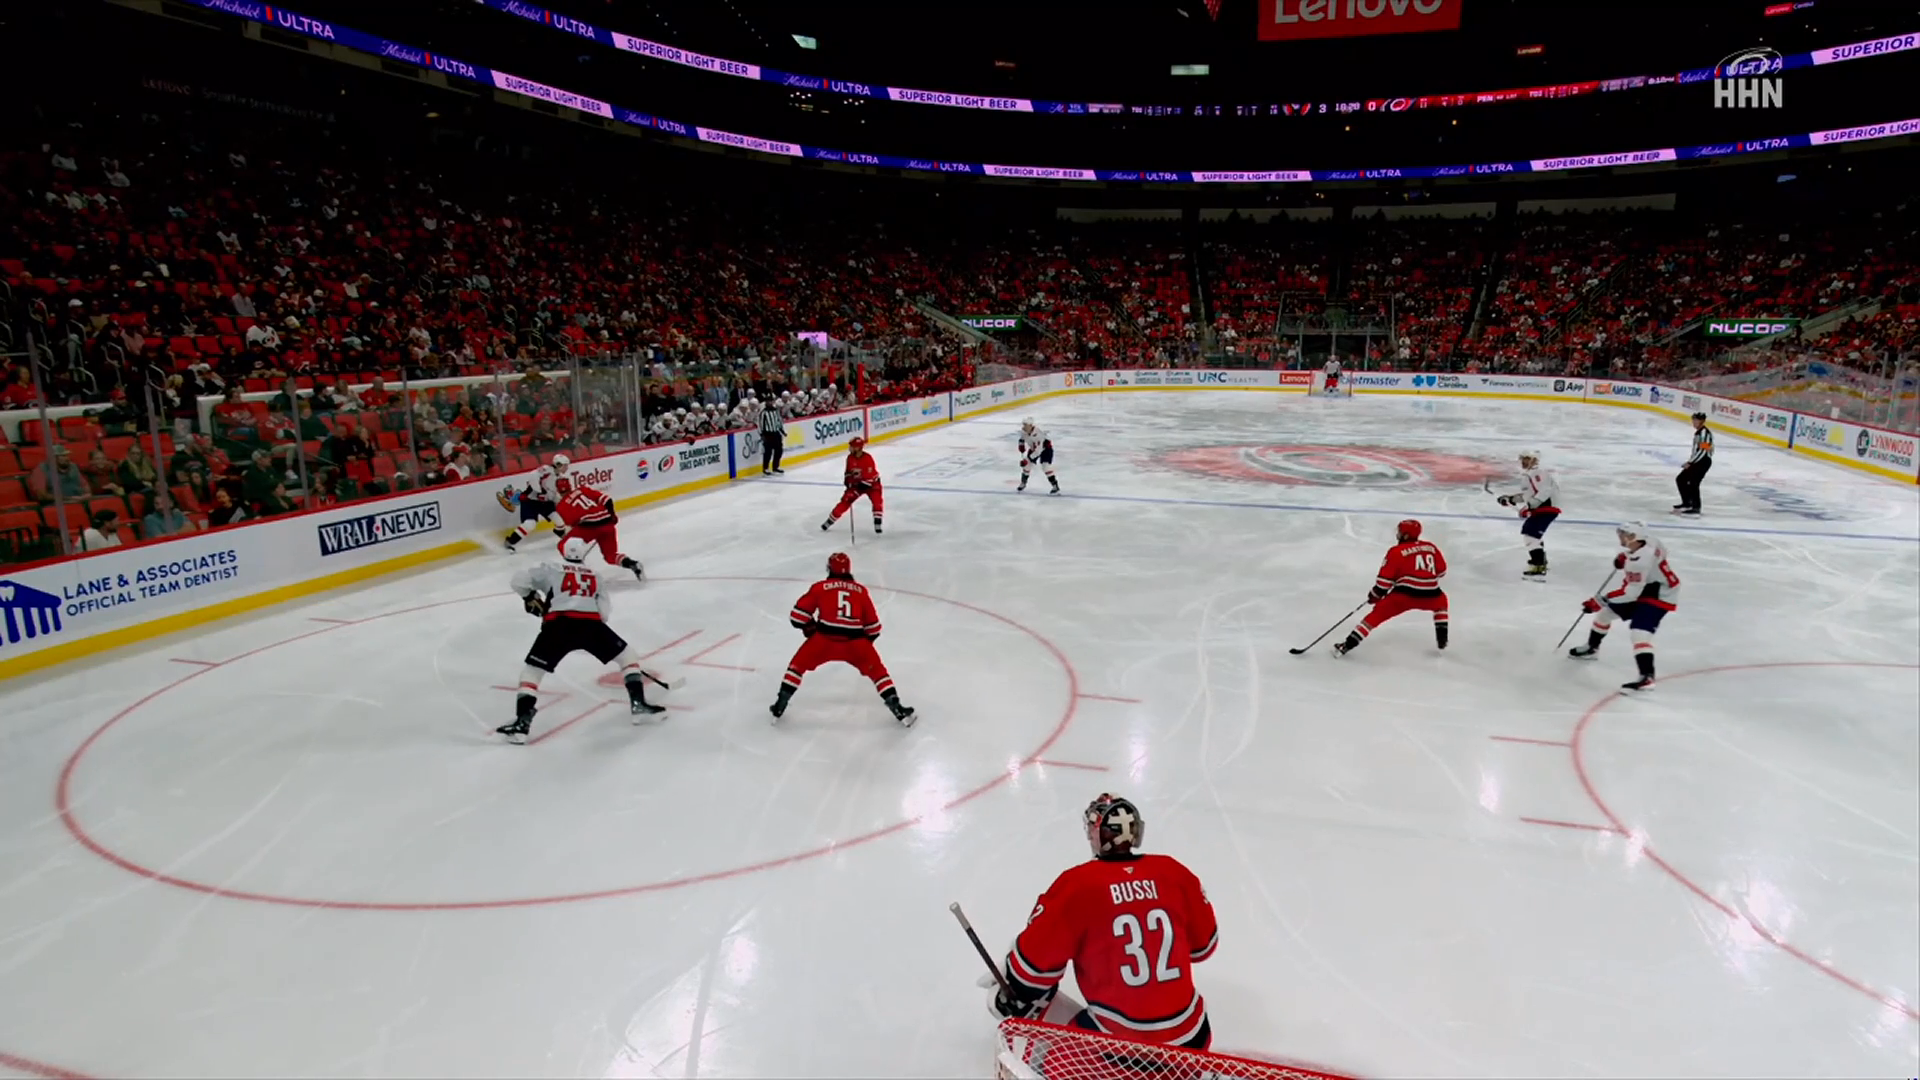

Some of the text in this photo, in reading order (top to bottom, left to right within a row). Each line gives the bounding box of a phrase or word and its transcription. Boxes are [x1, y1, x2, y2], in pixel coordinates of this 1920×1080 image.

[1275, 0, 1443, 24] Lenovo
[278, 10, 335, 39] ULTRA
[553, 14, 595, 39] ULTRA
[627, 38, 749, 76] SUPERIOR LIGHT BEER
[1831, 35, 1915, 61] SUPERIOR
[433, 56, 476, 79] ULTRA
[504, 76, 602, 113] SUPERIOR LIGHT BEER
[831, 81, 871, 96] ULTRA
[898, 90, 1017, 109] SUPERIOR LIGHT BEER
[1318, 104, 1327, 113] 3
[658, 119, 686, 135] ULTRA
[1823, 125, 1887, 142] SUPERIOR
[706, 131, 791, 153] SUPERIOR LIGHT BEER
[1746, 138, 1789, 151] ULTRA
[848, 153, 879, 164] ULTRA
[940, 162, 971, 173] ULTRA
[1542, 151, 1660, 169] SUPERIOR LIGHT BEER
[993, 167, 1034, 176] SUPERIOR
[1036, 169, 1061, 177] LIGHT
[1146, 173, 1178, 181] ULTRA
[1201, 172, 1245, 180] SUPERIOR
[1275, 172, 1299, 180] BEER
[1366, 169, 1402, 178] ULTRA
[1476, 163, 1514, 174] ULTRA
[961, 318, 1017, 328] NUCOR
[1074, 373, 1094, 385] PNC
[1197, 372, 1228, 383] UNC
[815, 417, 860, 444] Spectrum
[708, 454, 720, 464] ONE
[571, 468, 613, 488] Teeter
[572, 494, 598, 510] 74
[321, 507, 437, 553] WRAL NEWS
[63, 550, 237, 600] LANE & ASSOCIATES
[66, 565, 239, 616] OFFICIAL TEAM DENTIST
[561, 572, 597, 597] 43
[823, 581, 862, 593] CHATFIELD
[837, 590, 852, 618] 5
[1109, 880, 1158, 905] BUSSI
[1112, 908, 1181, 987] 32
